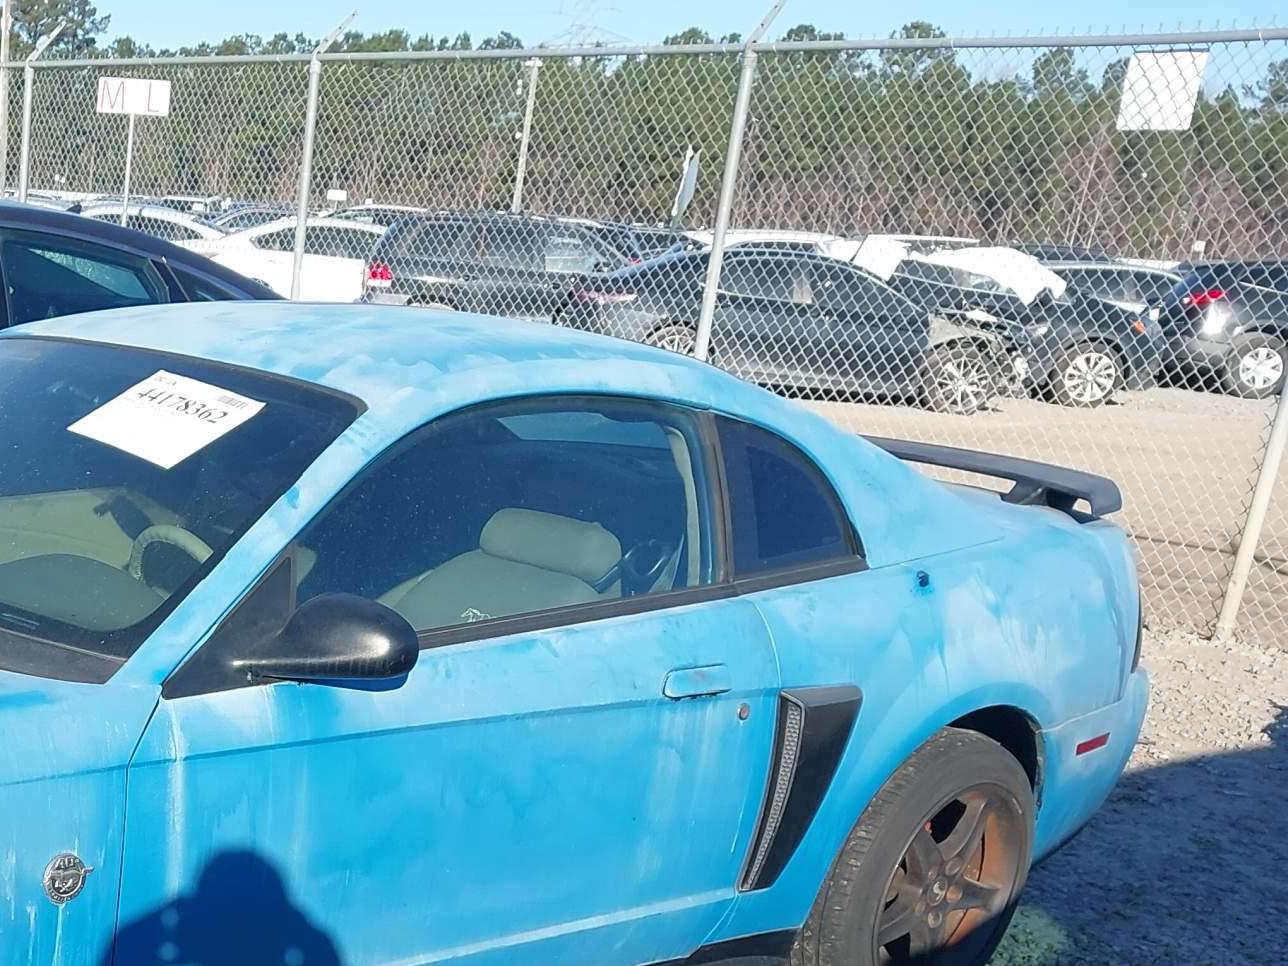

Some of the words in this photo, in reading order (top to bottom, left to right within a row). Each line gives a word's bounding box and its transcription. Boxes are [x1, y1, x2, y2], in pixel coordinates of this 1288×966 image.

[99, 79, 125, 112] M
[147, 80, 160, 113] L
[137, 387, 229, 424] 44178362
